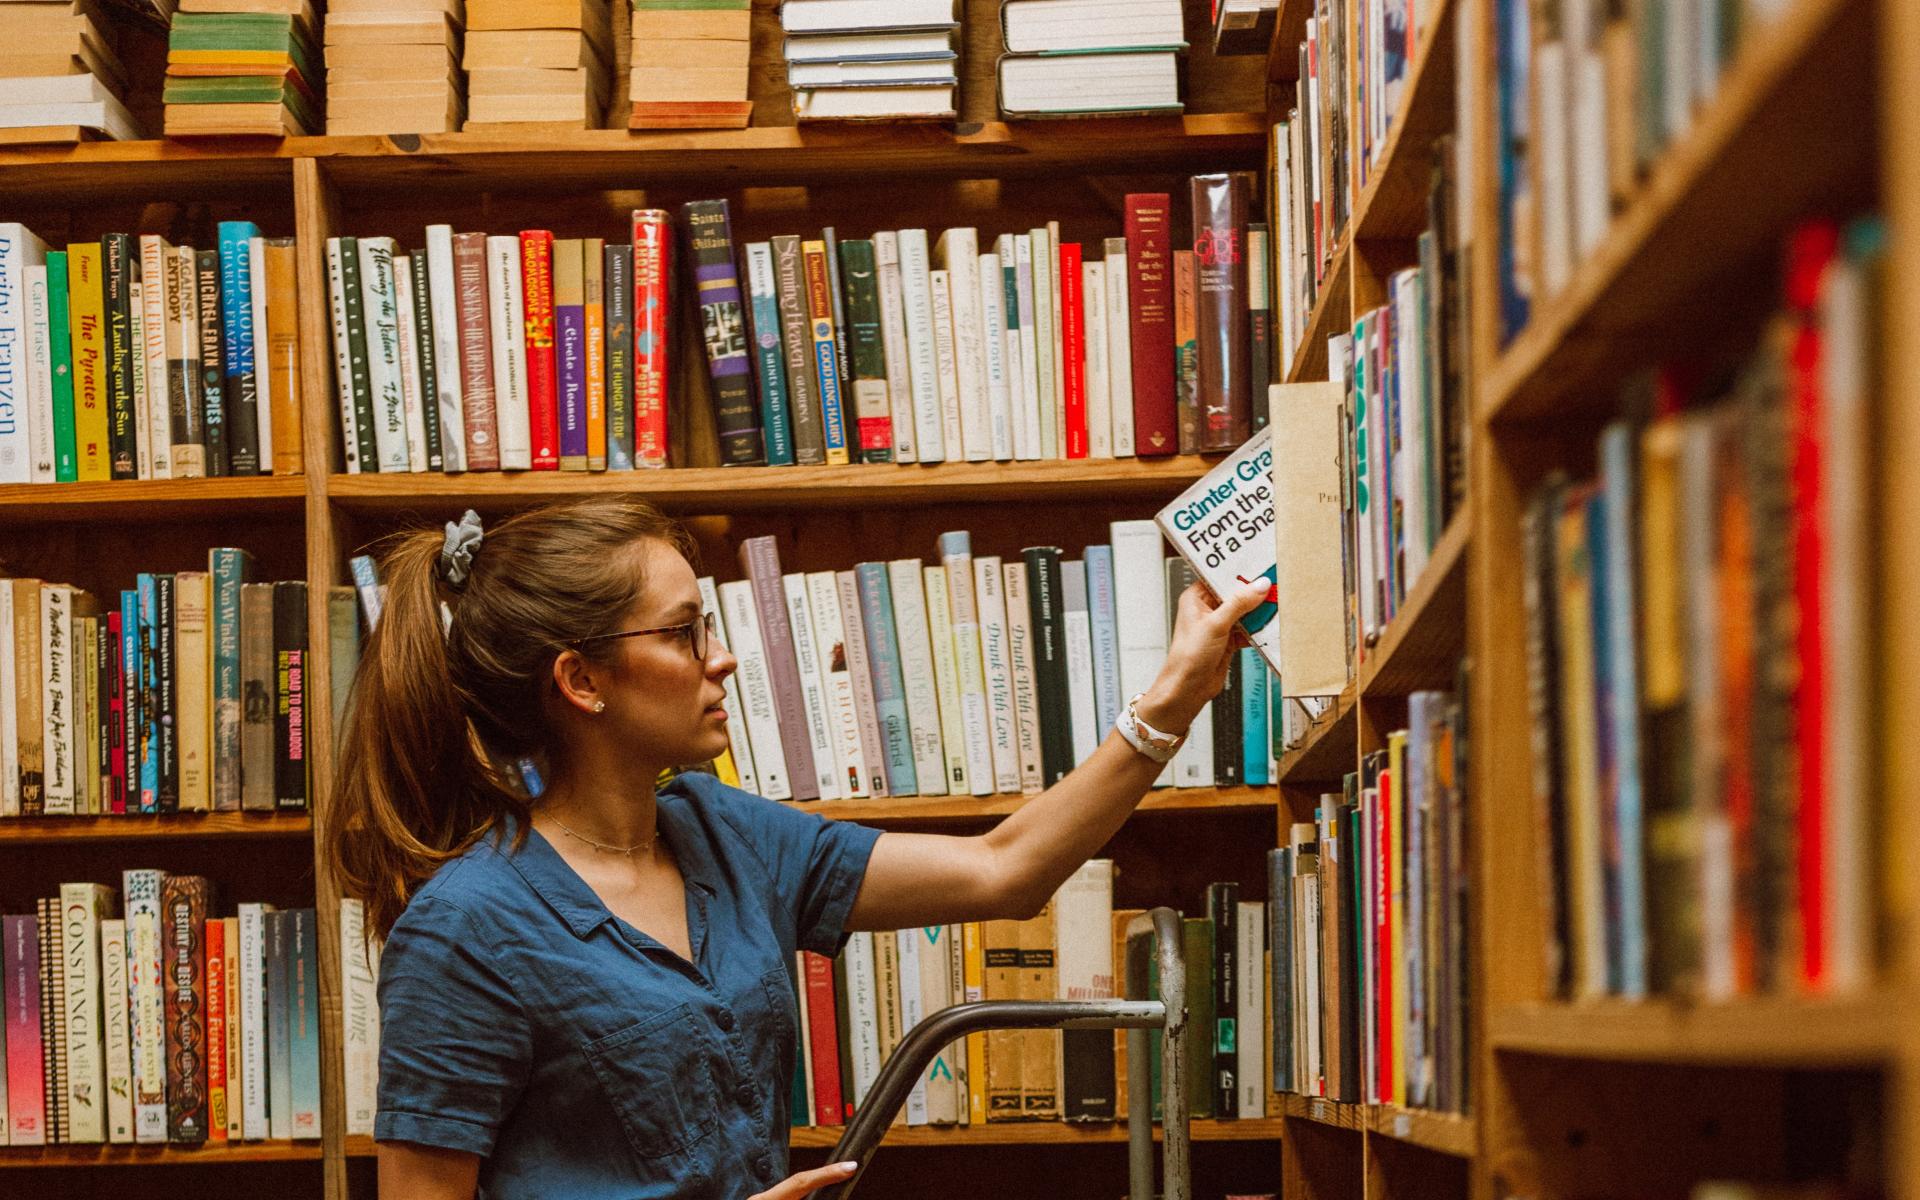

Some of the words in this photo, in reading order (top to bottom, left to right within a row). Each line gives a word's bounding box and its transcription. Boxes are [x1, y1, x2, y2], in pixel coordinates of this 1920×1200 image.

[80, 255, 92, 284] Fraser
[109, 239, 122, 273] Michael
[143, 242, 161, 306] MICHAEL
[222, 240, 236, 305] CHARLES
[236, 240, 250, 293] COLD
[369, 246, 394, 297] Elbowing
[614, 254, 623, 286] AMITAV
[636, 239, 648, 287] GHOSH
[780, 240, 802, 309] Storming
[109, 275, 121, 300] Frayn
[167, 256, 182, 323] ENTROPY
[180, 257, 195, 321] AGAINST
[200, 270, 217, 324] MICHAEL
[525, 240, 538, 315] CHROMOSOME
[32, 280, 44, 317] Caro
[112, 310, 124, 322] A
[382, 300, 395, 319] the
[414, 254, 428, 330] EXTRAORDINARY
[421, 334, 432, 371] PEOPLE
[614, 287, 623, 317] GHOSH
[81, 313, 97, 341] The
[132, 313, 142, 334] THE
[147, 312, 165, 361] FRAYN
[226, 311, 239, 371] FRAZIER
[787, 312, 806, 369] Heaven
[988, 305, 999, 338] ELLEN
[35, 321, 48, 366] Fraser
[112, 323, 127, 374] Landing
[132, 341, 142, 360] TIN
[202, 329, 220, 367] FRAYN
[239, 300, 257, 403] MOUNTAIN
[344, 250, 359, 335] SYLVIE
[353, 355, 370, 463] GERMAIN
[377, 319, 399, 365] Seducer
[564, 327, 578, 370] Circle
[589, 327, 601, 378] Shadow
[613, 350, 624, 369] THE
[820, 343, 833, 377] GOOD
[991, 342, 1001, 380] FOSTER
[0, 327, 17, 436] Franzen
[79, 347, 98, 410] Pyrates
[115, 375, 123, 388] on
[133, 363, 145, 394] MEN
[648, 370, 661, 394] Sea
[839, 356, 849, 381] Moon
[115, 390, 130, 410] the
[206, 386, 222, 425] SPIES
[567, 383, 580, 431] Reason
[591, 382, 602, 419] Lines
[613, 371, 624, 413] HUNGRY
[637, 363, 651, 418] Poppies
[795, 375, 810, 425] GIARDINA
[824, 378, 835, 406] KING
[115, 411, 129, 436] Sun
[614, 414, 625, 439] TIDE
[826, 407, 842, 446] HARRY
[1174, 477, 1237, 531] Günter
[1236, 447, 1273, 482] Gra
[1187, 510, 1240, 552] From
[1236, 485, 1271, 514] the
[1206, 542, 1226, 568] of
[1226, 537, 1242, 553] a
[1237, 500, 1275, 541] Sna
[216, 553, 236, 579] Rip
[1038, 558, 1050, 581] ELLEN
[161, 580, 169, 625] Columbus
[219, 579, 236, 604] Van
[843, 582, 856, 610] Ellen
[1040, 581, 1052, 620] GILCHRIST
[1098, 558, 1109, 616] GILCHRIST
[220, 607, 237, 657] Winkle
[847, 615, 862, 666] Gilchrist
[986, 623, 1002, 670] Drunk
[1010, 625, 1027, 672] Drunk
[126, 636, 135, 688] COLUMBUS
[161, 627, 170, 678] Slaughters
[289, 650, 301, 667] THE
[1101, 636, 1115, 702] DANGEROUS
[290, 668, 301, 691] ROAD
[290, 693, 302, 704] TO
[990, 673, 1007, 712] With
[1014, 677, 1033, 714] With
[127, 689, 137, 752] SLAUGHTERS
[836, 681, 857, 758] RHODA
[996, 715, 1010, 749] Love
[1018, 718, 1034, 752] Love
[1105, 705, 1116, 729] AGE
[885, 714, 906, 767] Gilchrist
[926, 733, 940, 756] Ellen
[128, 754, 138, 792] BRAVES
[175, 904, 190, 947] DESTINY
[245, 913, 255, 930] The
[179, 949, 189, 964] AND
[244, 934, 255, 974] Crystal
[885, 946, 893, 970] CONEY
[66, 903, 89, 1053] CONSTANCIA
[177, 966, 193, 1003] DESIRE
[886, 971, 894, 999] ISLAND
[1067, 986, 1114, 1001] MILLION
[1092, 974, 1114, 988] ONE
[246, 976, 256, 1021] Frontier
[182, 1012, 193, 1050] CARLOS
[183, 1052, 193, 1096] FUENTES
[248, 1067, 256, 1106] FUENTES
[212, 1091, 228, 1127] USED
